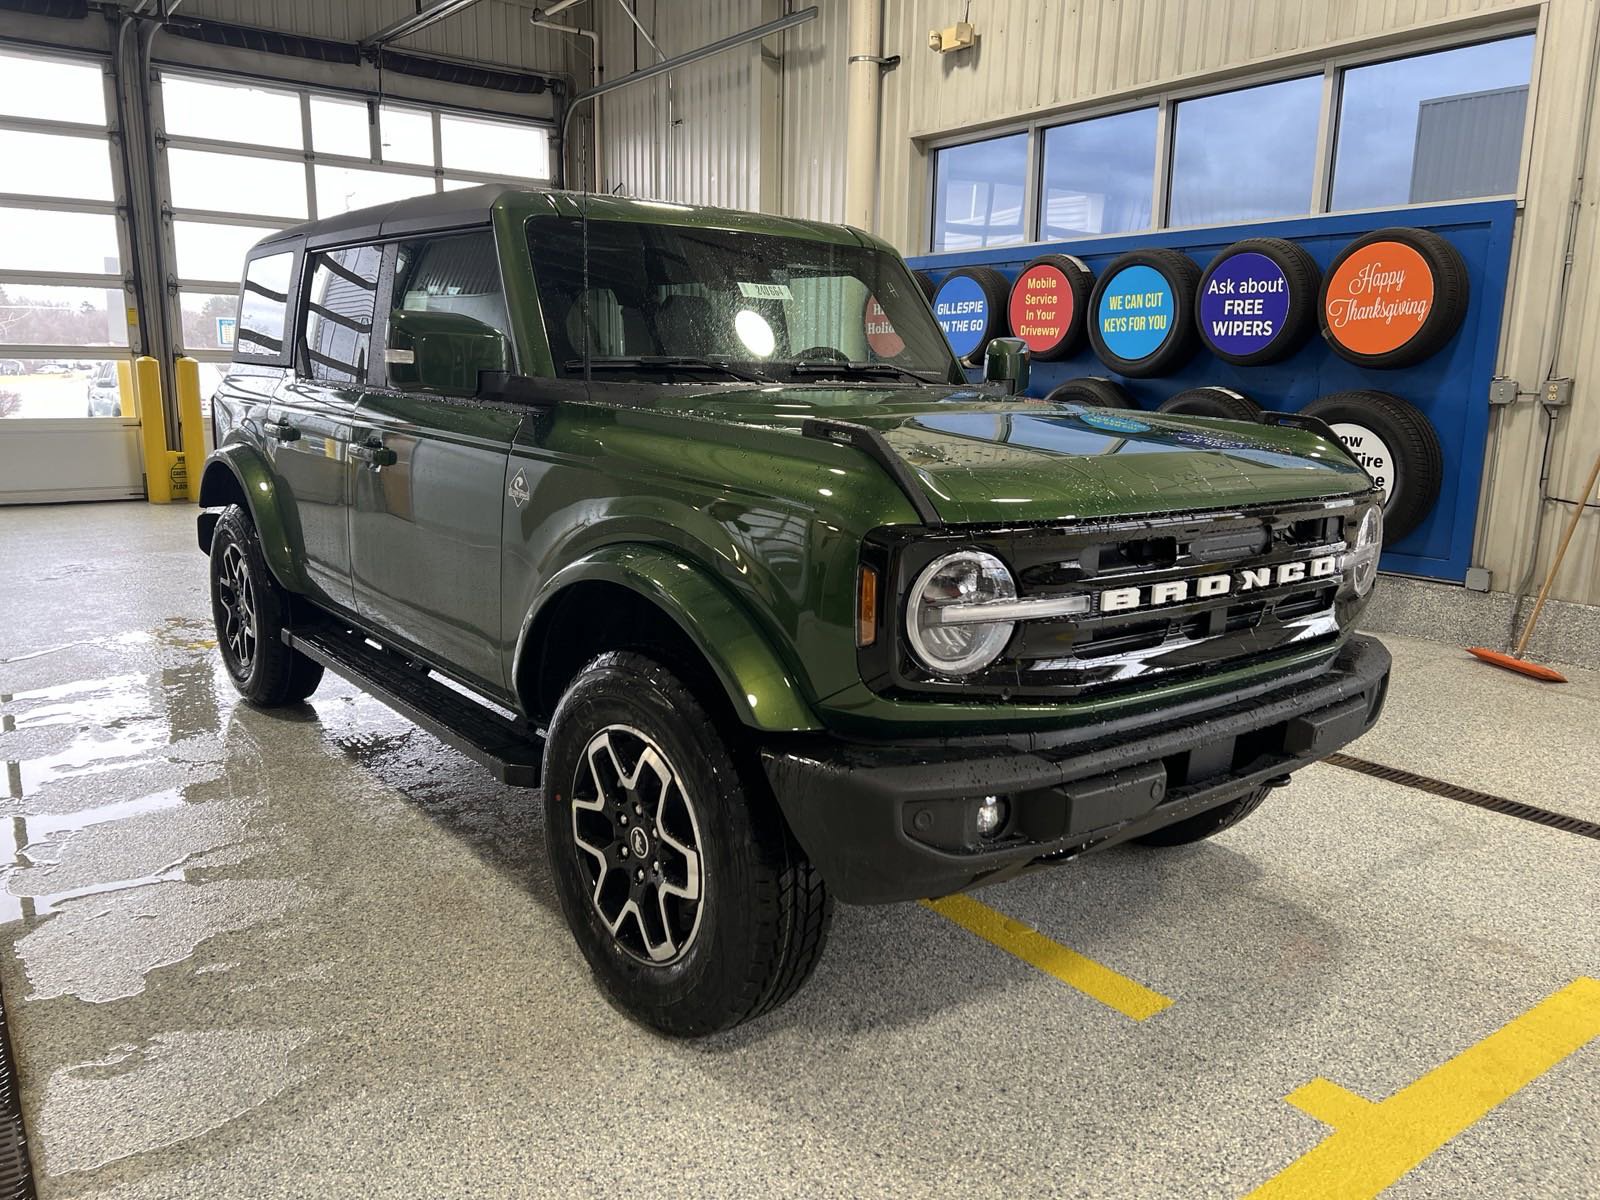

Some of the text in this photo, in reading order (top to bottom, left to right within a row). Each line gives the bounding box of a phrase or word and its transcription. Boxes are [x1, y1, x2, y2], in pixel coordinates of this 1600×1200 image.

[1027, 277, 1057, 289] Mobile
[1207, 277, 1284, 295] Ask about
[1349, 262, 1406, 295] Happy
[937, 300, 984, 315] GILLESPIE
[1025, 293, 1058, 305] Service
[1109, 292, 1164, 311] WE CAN CUT
[1224, 299, 1264, 316] FREE
[1025, 309, 1056, 321] In Your
[1328, 297, 1428, 328] Thanksgiving
[951, 320, 969, 333] THE
[970, 319, 984, 332] GO
[1020, 324, 1060, 339] Driveway
[1104, 314, 1168, 333] KEYS FOR YOU
[1212, 320, 1273, 337] WIPERS
[1101, 556, 1336, 612] BRONCO
